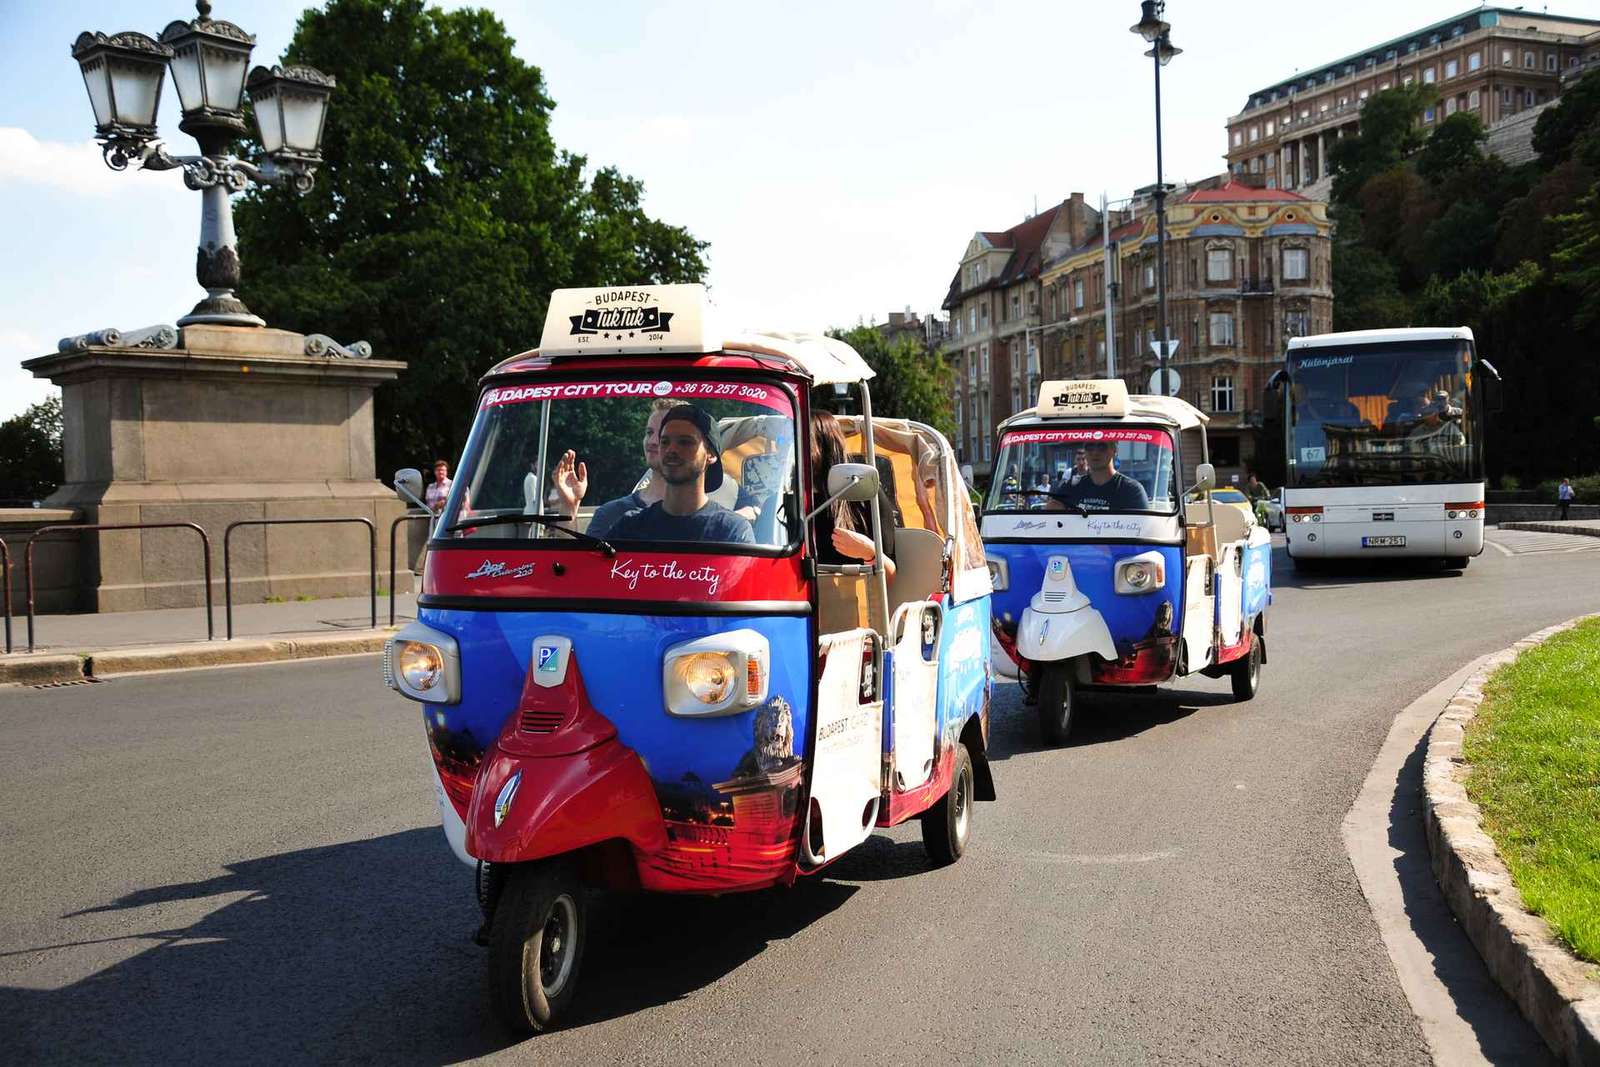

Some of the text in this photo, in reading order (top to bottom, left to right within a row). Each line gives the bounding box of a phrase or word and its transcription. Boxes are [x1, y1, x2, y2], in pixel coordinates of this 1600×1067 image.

[595, 291, 650, 305] BUDAPEST
[486, 386, 563, 405] BUDAPEST
[564, 384, 603, 395] CITY
[604, 382, 652, 394] TOUR
[674, 384, 697, 393] +36
[699, 385, 713, 393] 70
[714, 384, 738, 394] 257
[738, 386, 767, 399] 3020
[1045, 432, 1067, 440] CITY
[1067, 432, 1092, 440] TOUR
[611, 559, 720, 595] Key to the city
